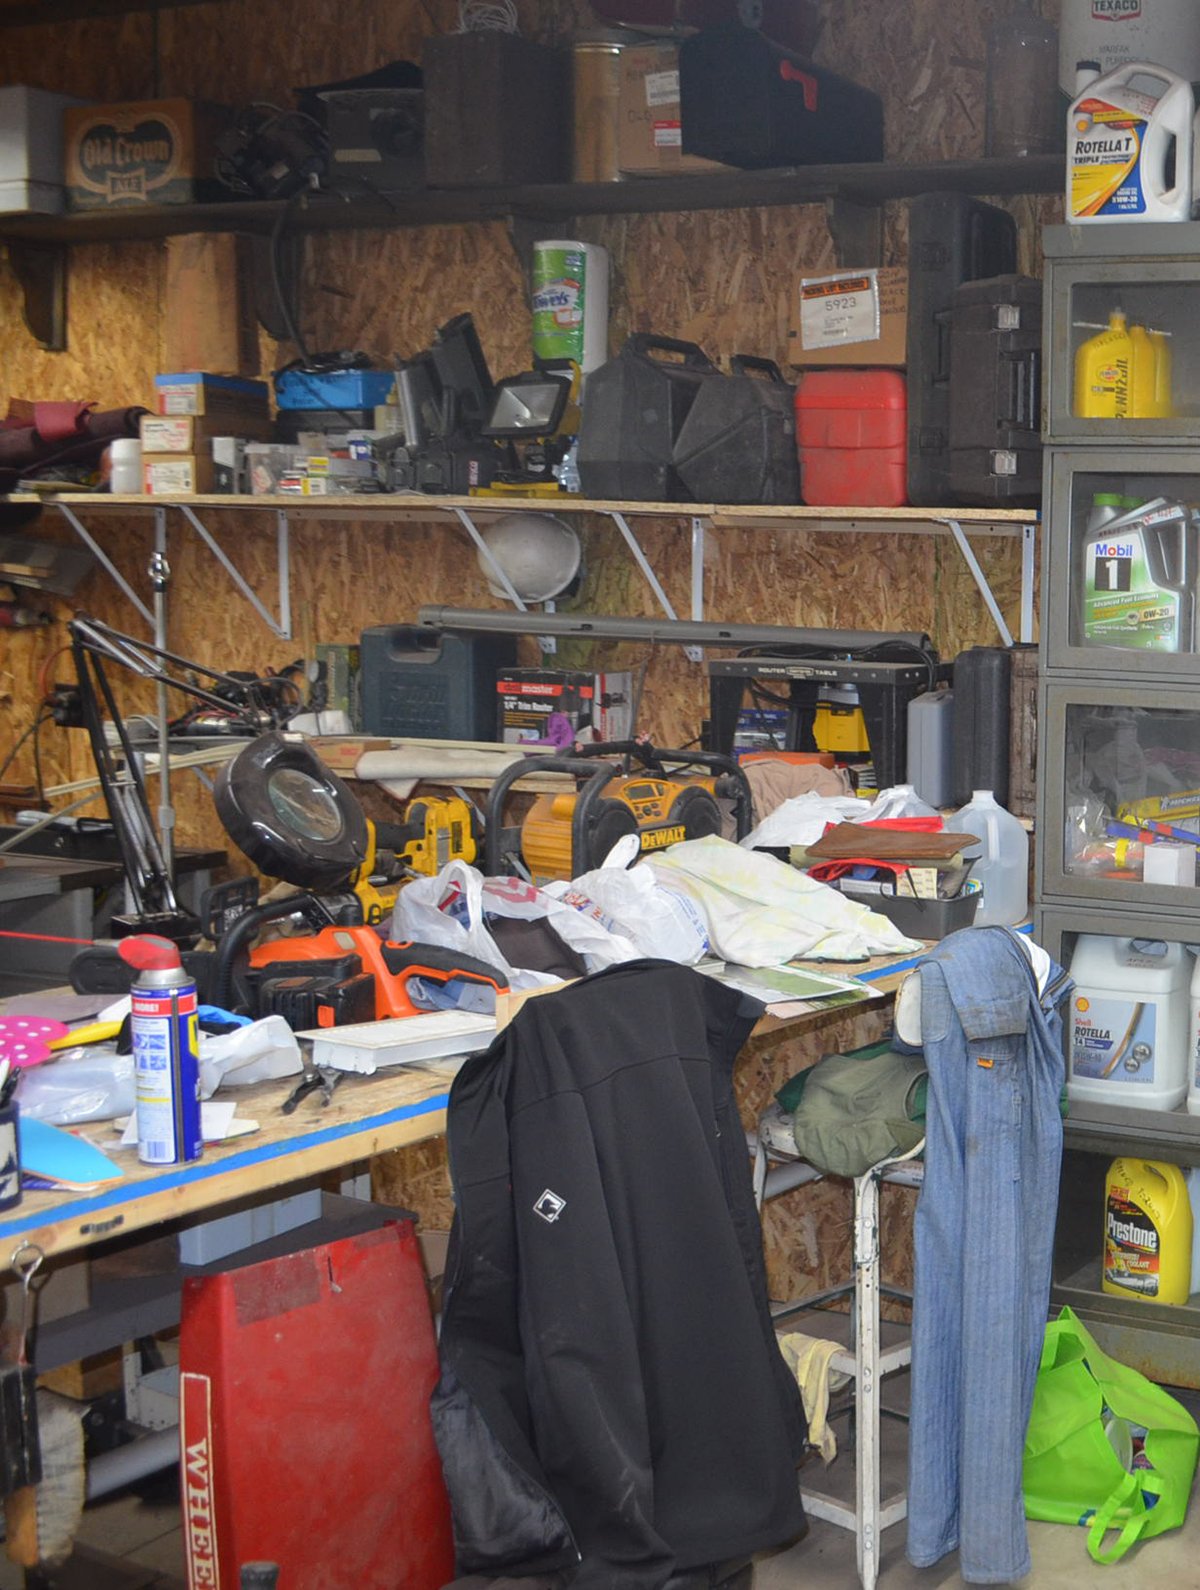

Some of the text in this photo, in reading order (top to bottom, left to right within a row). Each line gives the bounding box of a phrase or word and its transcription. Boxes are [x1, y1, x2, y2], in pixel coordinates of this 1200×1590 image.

[1094, 0, 1138, 11] TEXACO
[115, 136, 169, 166] Crown
[1075, 137, 1133, 155] ROTELLA T
[1073, 155, 1100, 165] TRIPLE
[825, 297, 857, 311] 5923
[1095, 544, 1132, 557] Mobil
[1104, 559, 1118, 590] 1
[1144, 607, 1170, 619] 0W-20
[1075, 1026, 1111, 1039] ROTELLA
[1107, 1212, 1157, 1249] Prestone
[186, 1437, 216, 1590] WHEE
